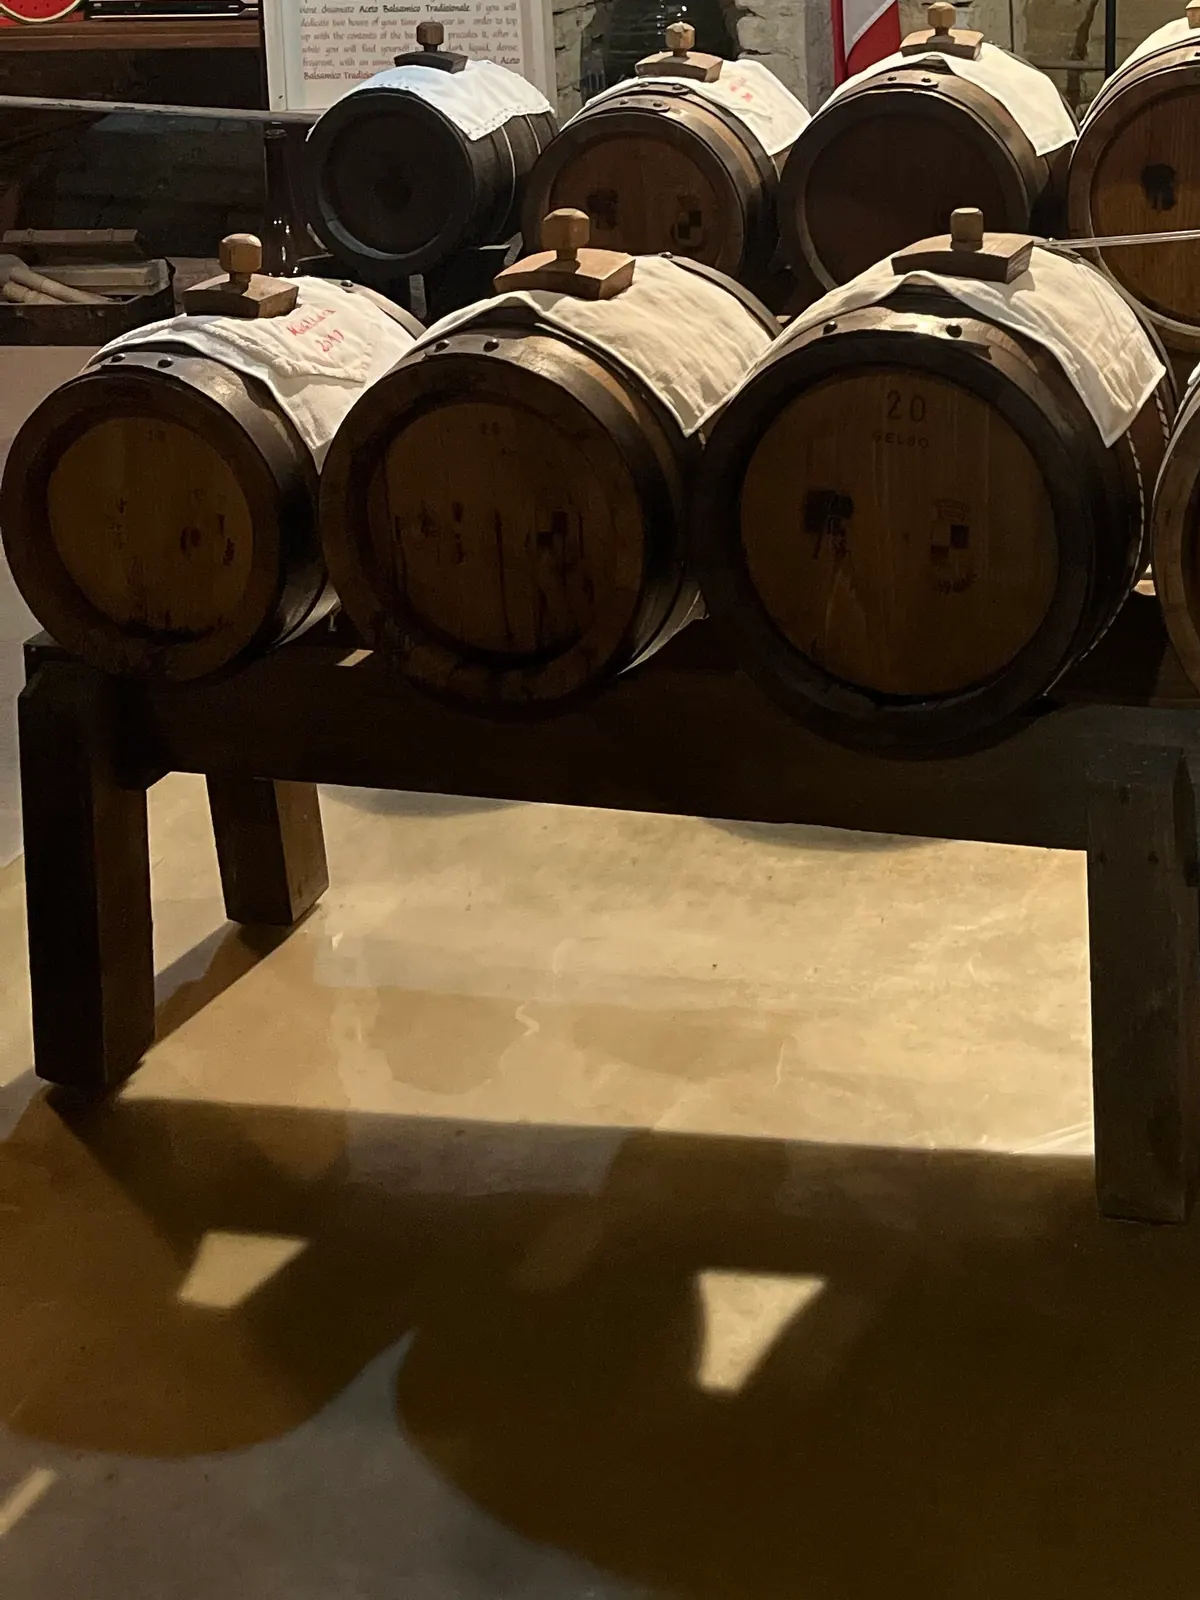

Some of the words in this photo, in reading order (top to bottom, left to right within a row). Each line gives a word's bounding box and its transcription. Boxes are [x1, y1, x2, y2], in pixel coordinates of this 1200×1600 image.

[383, 4, 420, 12] Balsamico
[304, 71, 341, 80] Balsamico
[886, 389, 926, 422] 20
